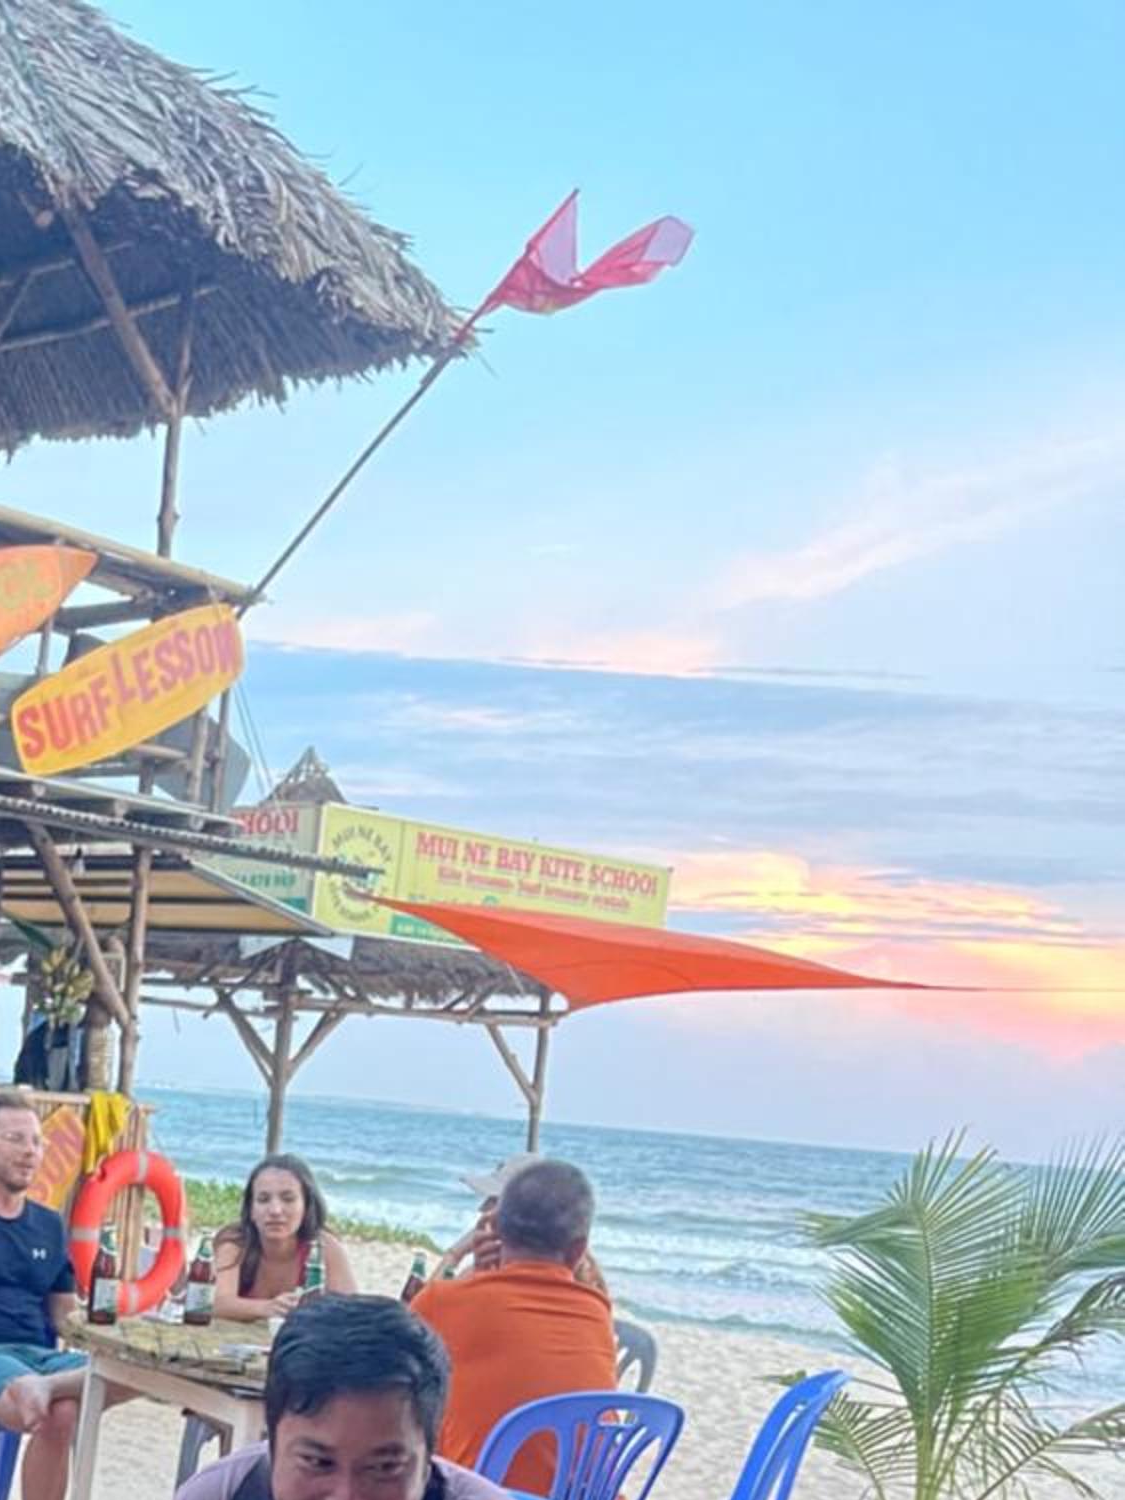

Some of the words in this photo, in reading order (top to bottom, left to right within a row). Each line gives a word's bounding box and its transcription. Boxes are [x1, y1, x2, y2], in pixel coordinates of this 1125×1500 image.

[17, 674, 113, 759] SURF
[109, 620, 240, 705] LESSON
[416, 831, 458, 860] MUI
[463, 841, 492, 865] NE
[496, 848, 537, 873] BAY
[539, 854, 586, 883] KITE
